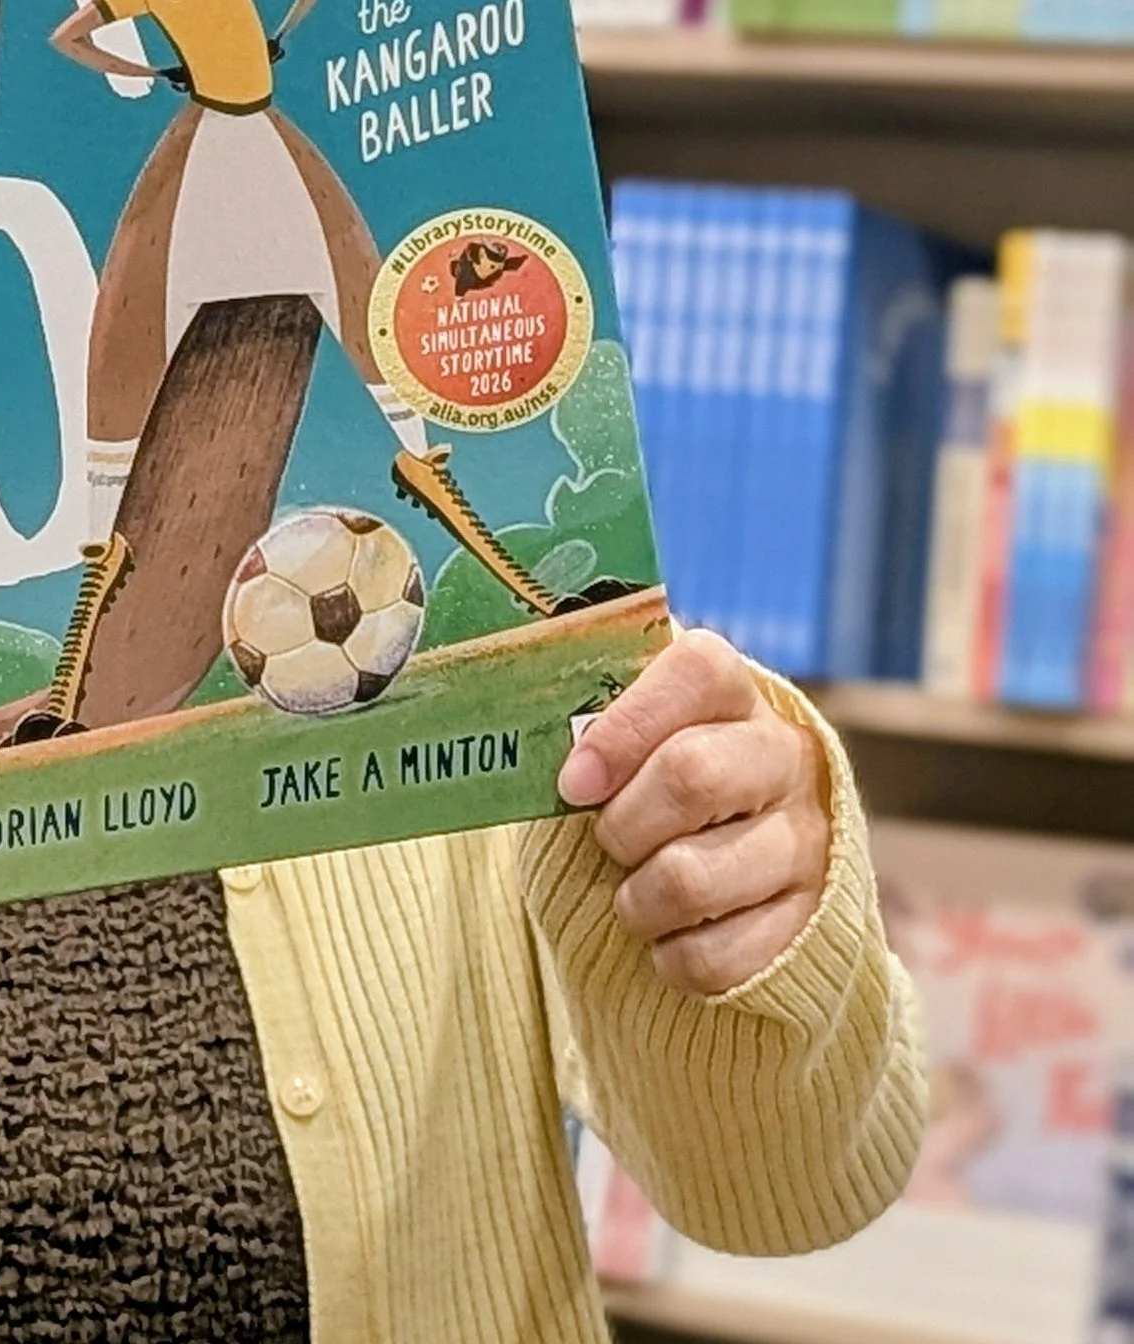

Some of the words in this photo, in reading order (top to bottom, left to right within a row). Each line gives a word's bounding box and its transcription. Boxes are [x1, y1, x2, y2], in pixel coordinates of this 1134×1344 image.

[360, 71, 495, 163] BALLER
[391, 214, 558, 275] #LibraryStorytime
[420, 314, 546, 356] SIMULTANEOUS
[436, 294, 524, 328] NATIONAL
[439, 341, 534, 377] STORYTIME
[429, 381, 559, 429] alia.org.au/nss
[469, 372, 513, 398] 2026
[260, 757, 342, 808] JAKE
[362, 751, 385, 793] A
[400, 729, 520, 786] MINTON
[104, 780, 198, 833] LLOYD
